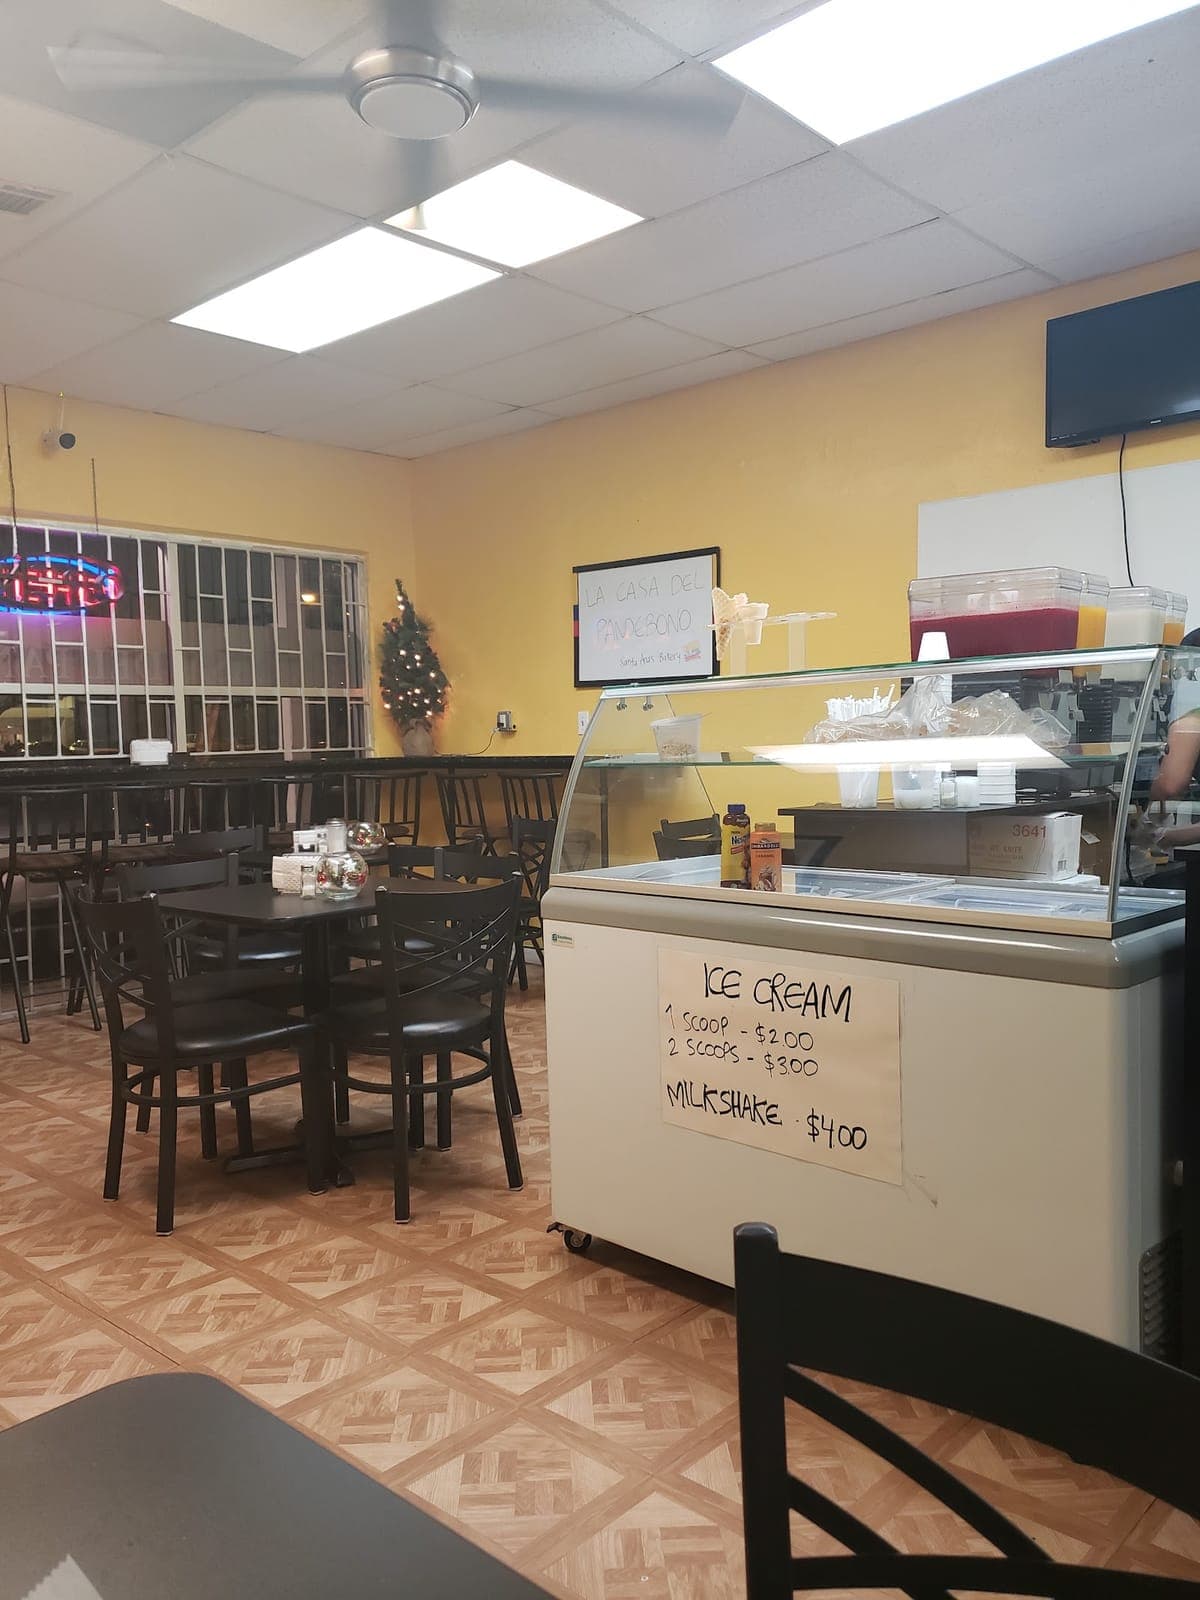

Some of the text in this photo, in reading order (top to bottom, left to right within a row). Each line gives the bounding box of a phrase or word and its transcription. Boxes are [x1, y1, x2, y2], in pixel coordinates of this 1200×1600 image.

[585, 569, 704, 608] LA CASA DEL
[596, 609, 691, 641] PANDEBONO
[1012, 824, 1047, 839] 3641
[703, 962, 852, 1023] ICE CREAM
[665, 1003, 676, 1029] 1
[682, 1011, 729, 1037] SCOOP
[755, 1022, 815, 1051] $2.00
[667, 1037, 679, 1057] 2
[687, 1038, 740, 1064] SCOOPS
[763, 1053, 819, 1078] $3.00
[666, 1079, 783, 1126] MILKSHAKE
